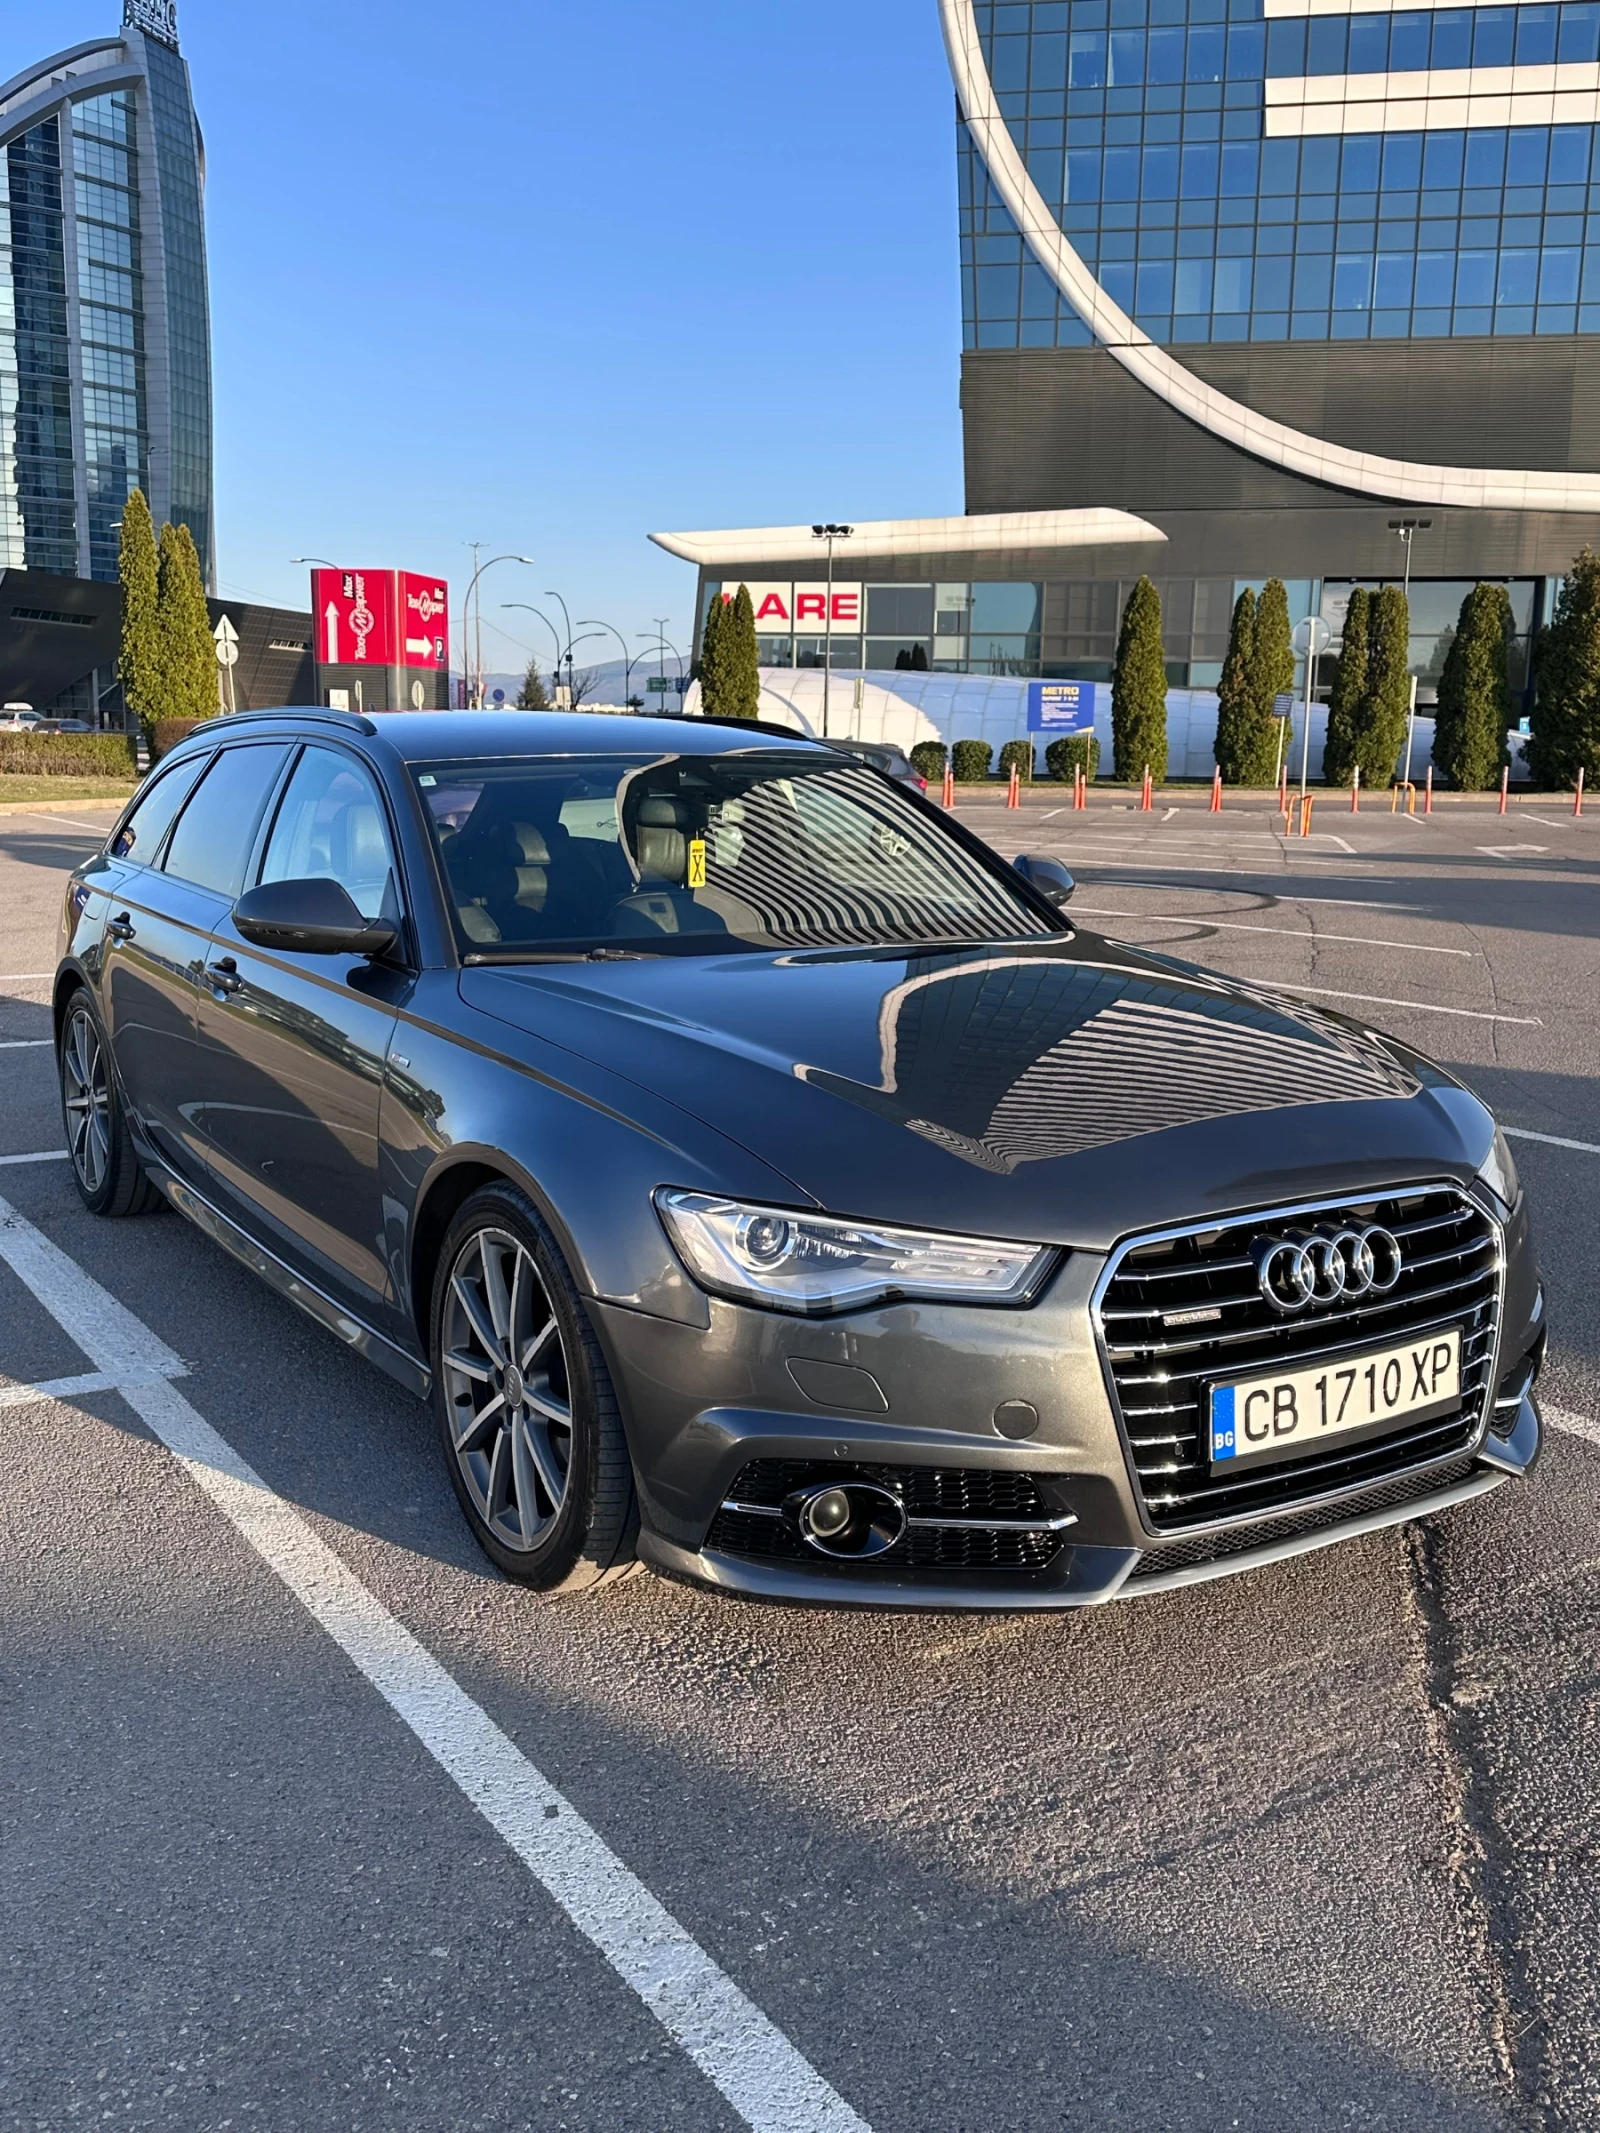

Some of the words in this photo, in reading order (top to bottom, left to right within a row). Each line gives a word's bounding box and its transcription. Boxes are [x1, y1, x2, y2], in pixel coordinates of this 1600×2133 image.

[722, 593, 858, 620] ARE
[436, 640, 443, 657] P
[1041, 686, 1080, 696] METRO
[692, 854, 704, 882] X
[1165, 1310, 1220, 1325] quattro
[1244, 1383, 1299, 1442] CB
[1315, 1358, 1401, 1426] 1710
[1410, 1342, 1451, 1402] XP
[1214, 1432, 1234, 1450] BG
